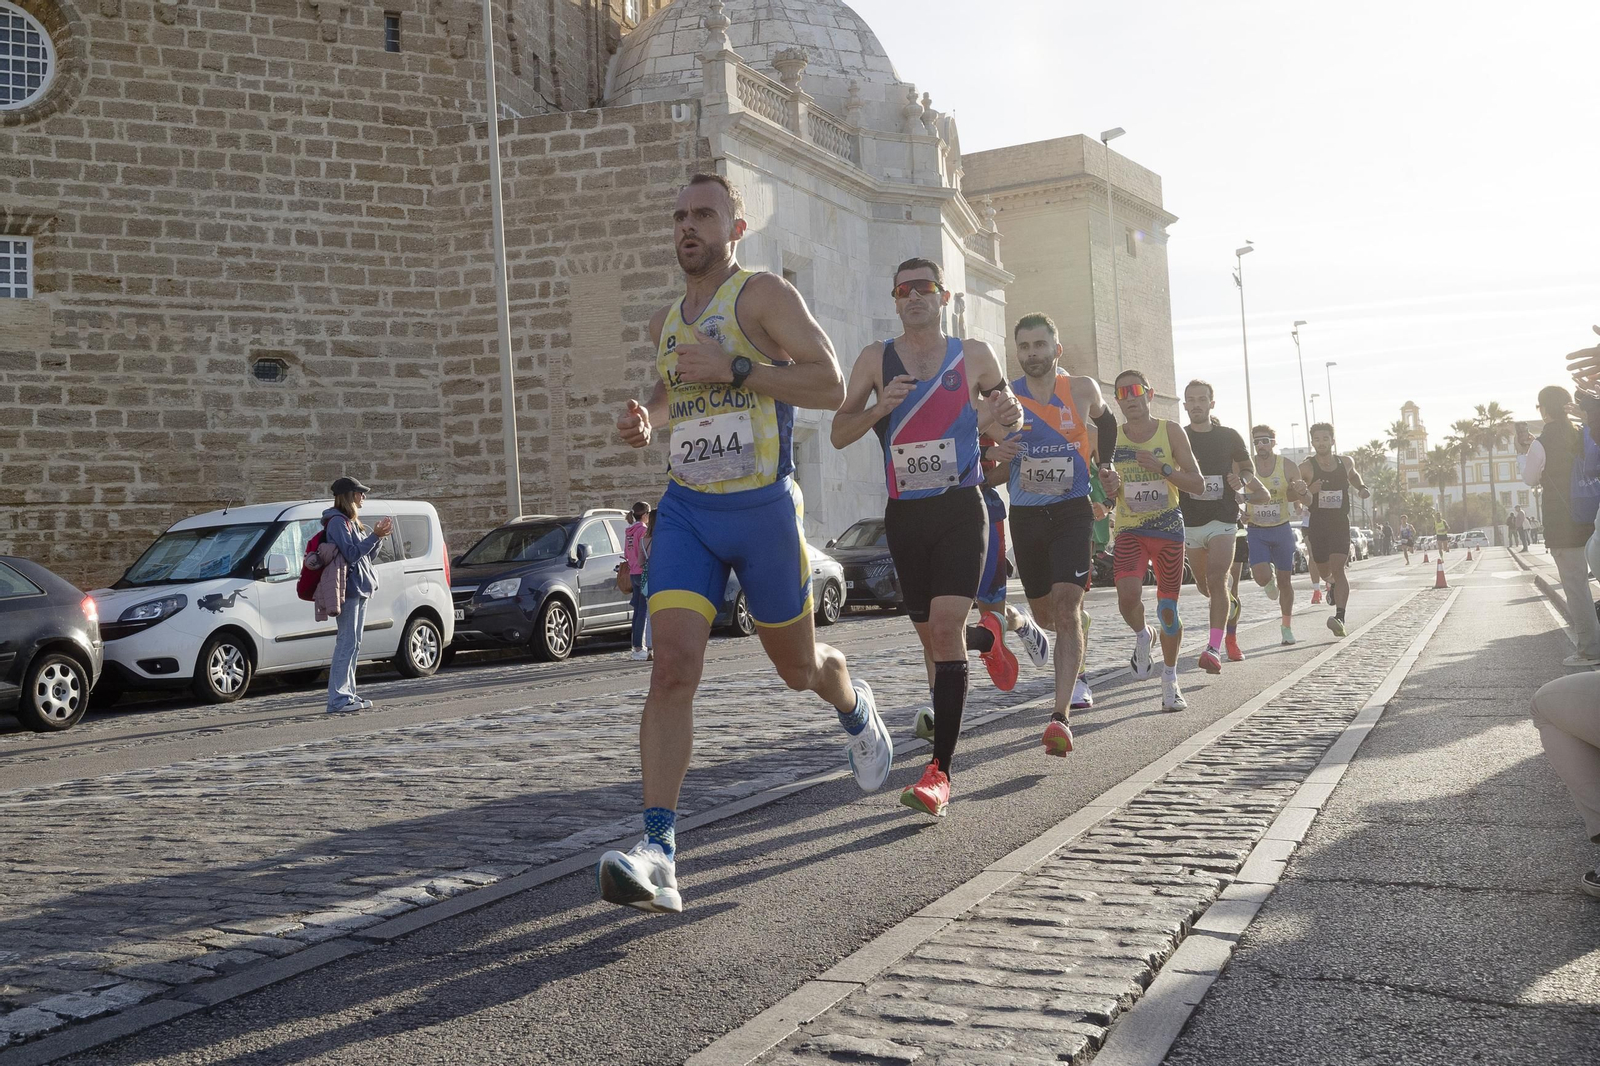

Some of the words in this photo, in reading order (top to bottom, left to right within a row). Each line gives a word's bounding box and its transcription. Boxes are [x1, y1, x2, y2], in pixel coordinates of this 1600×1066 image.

[669, 397, 706, 420] LIMPO
[680, 431, 743, 464] 2244
[1032, 441, 1081, 454] KAEFER
[907, 454, 942, 474] 868
[1026, 468, 1066, 483] 1547
[1134, 489, 1159, 502] 470
